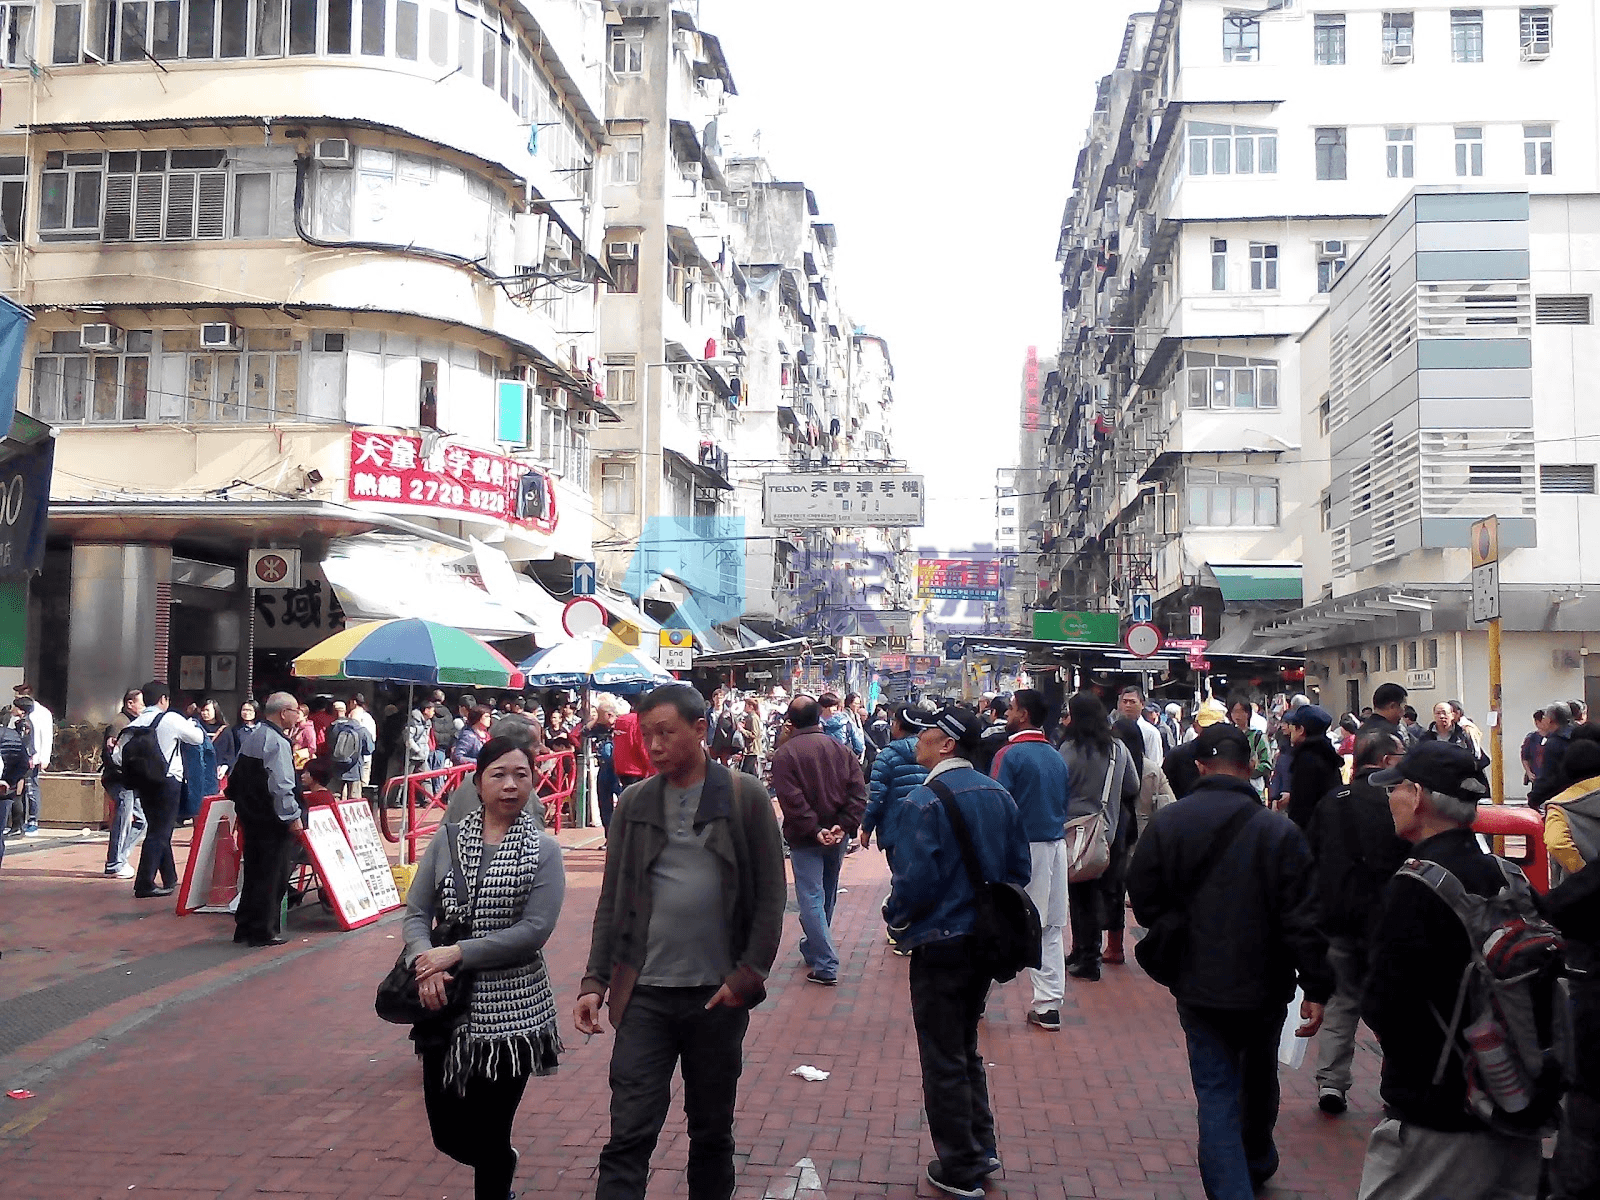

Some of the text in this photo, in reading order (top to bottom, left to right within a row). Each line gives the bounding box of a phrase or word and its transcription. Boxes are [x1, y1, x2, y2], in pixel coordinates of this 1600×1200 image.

[768, 485, 808, 493] TELSDA
[669, 649, 684, 657] End
[665, 658, 686, 668] 終止
